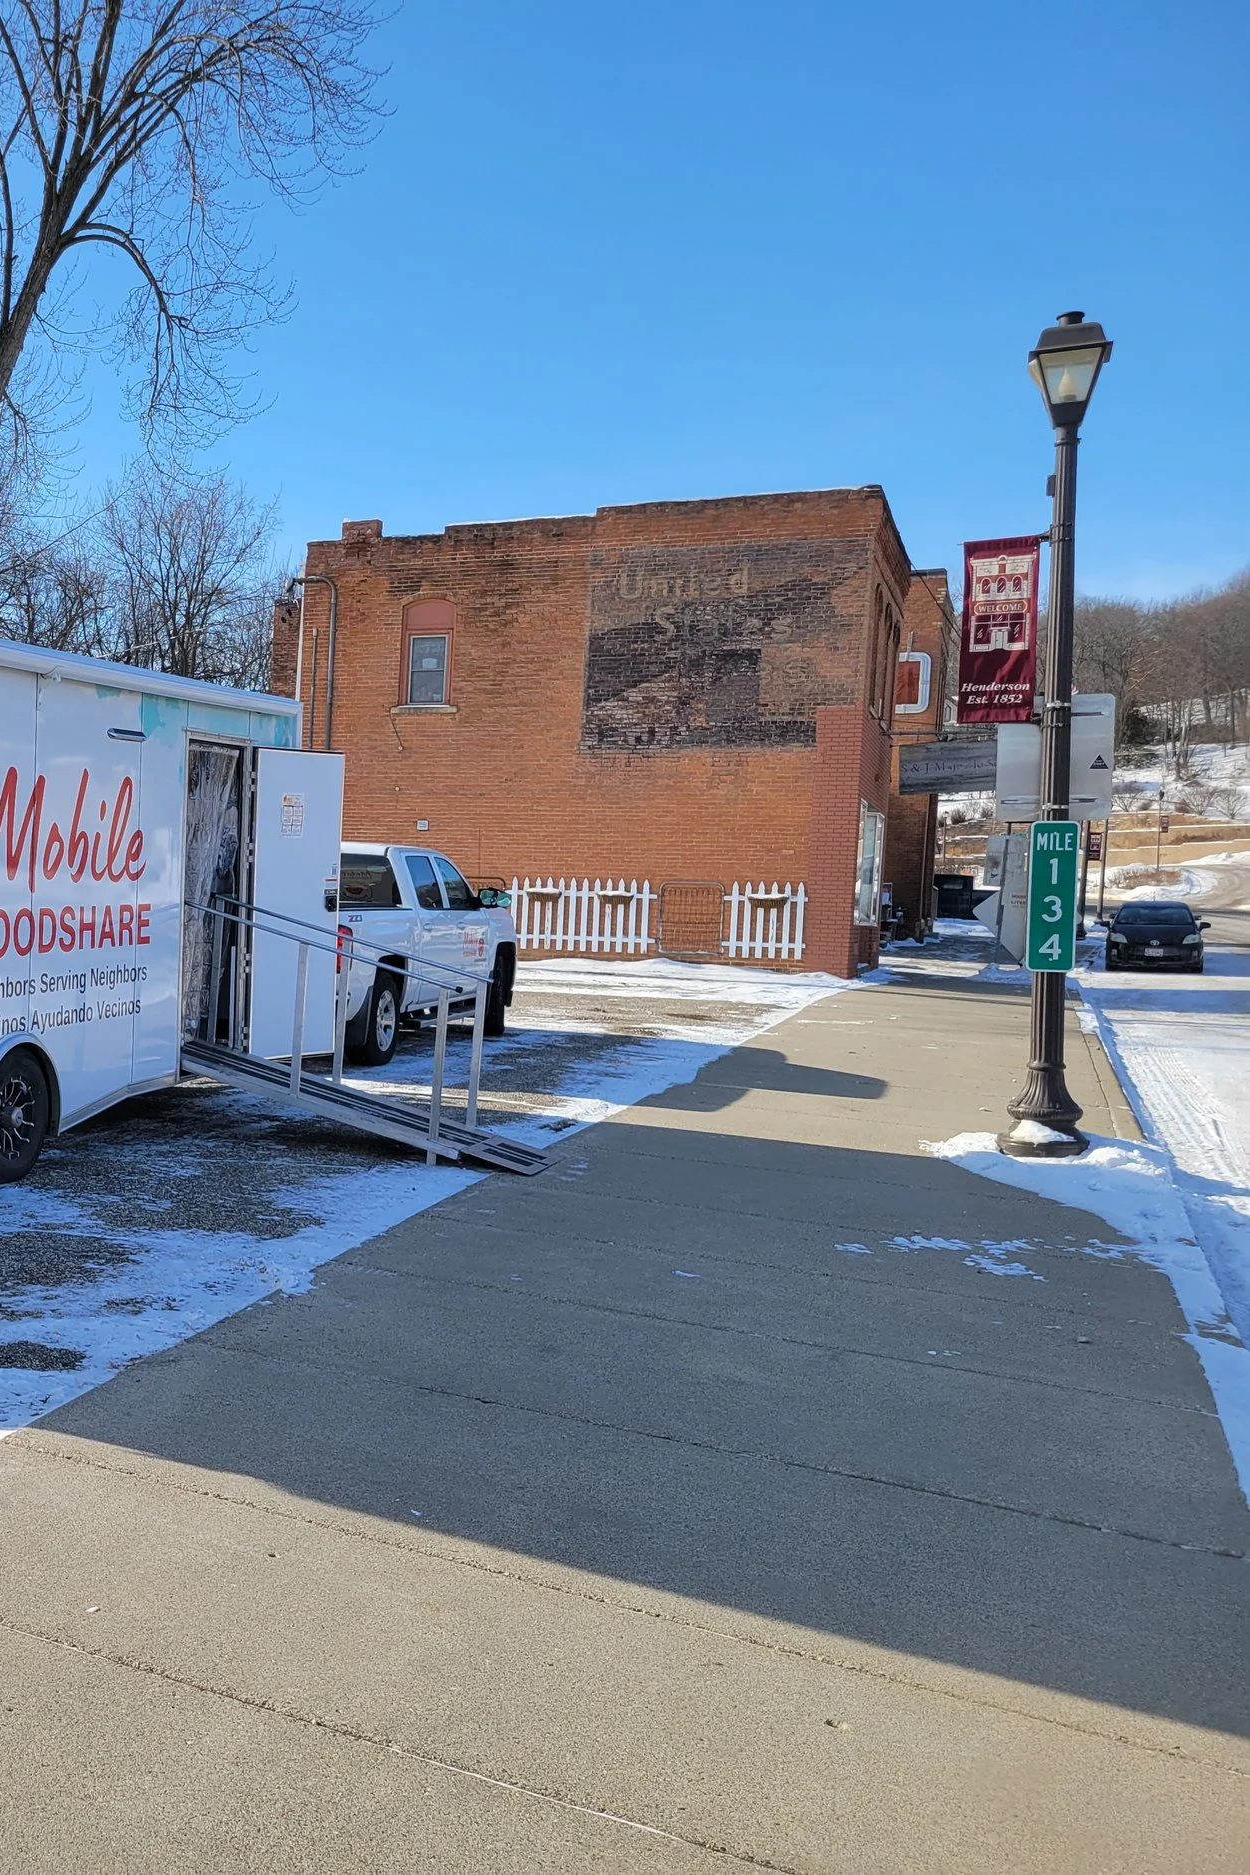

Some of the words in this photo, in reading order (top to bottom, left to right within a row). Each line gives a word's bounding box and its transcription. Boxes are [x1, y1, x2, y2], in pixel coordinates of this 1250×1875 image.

[978, 603, 1023, 612] WELCOME
[961, 682, 1030, 692] Henderson
[966, 695, 988, 704] Est.
[993, 694, 1023, 704] 1852
[1036, 832, 1074, 851] MILE
[40, 969, 87, 994] Serving
[90, 963, 148, 991] Neighbors
[31, 1001, 93, 1035] Ayudando
[96, 997, 141, 1021] Vecinos
